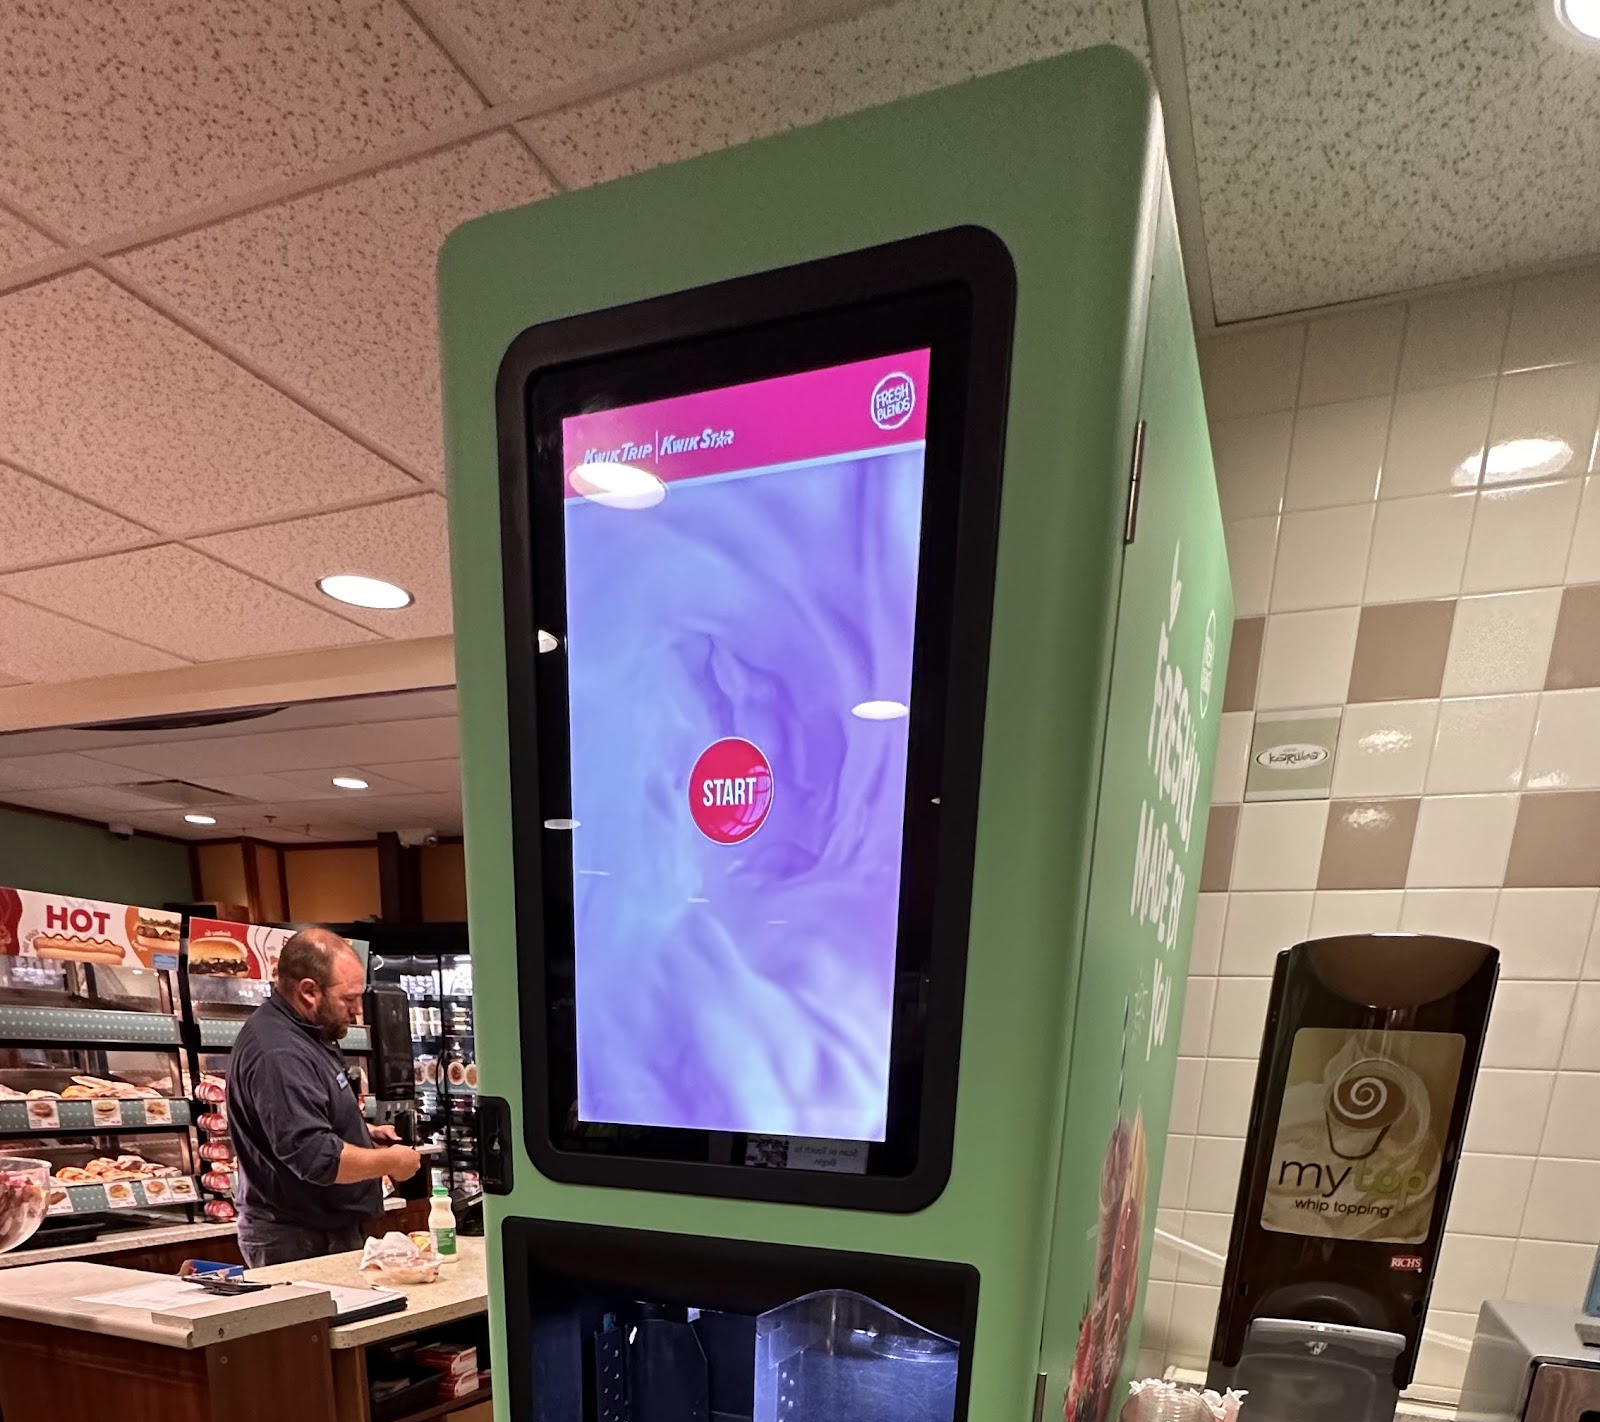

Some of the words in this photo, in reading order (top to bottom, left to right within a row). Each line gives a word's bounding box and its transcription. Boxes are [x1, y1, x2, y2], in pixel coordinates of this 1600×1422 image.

[876, 382, 909, 409] FRESH
[877, 397, 910, 421] BLENDS
[702, 777, 757, 807] START
[46, 905, 111, 935] HOT
[1295, 1198, 1329, 1213] whip
[1333, 1201, 1391, 1218] topping
